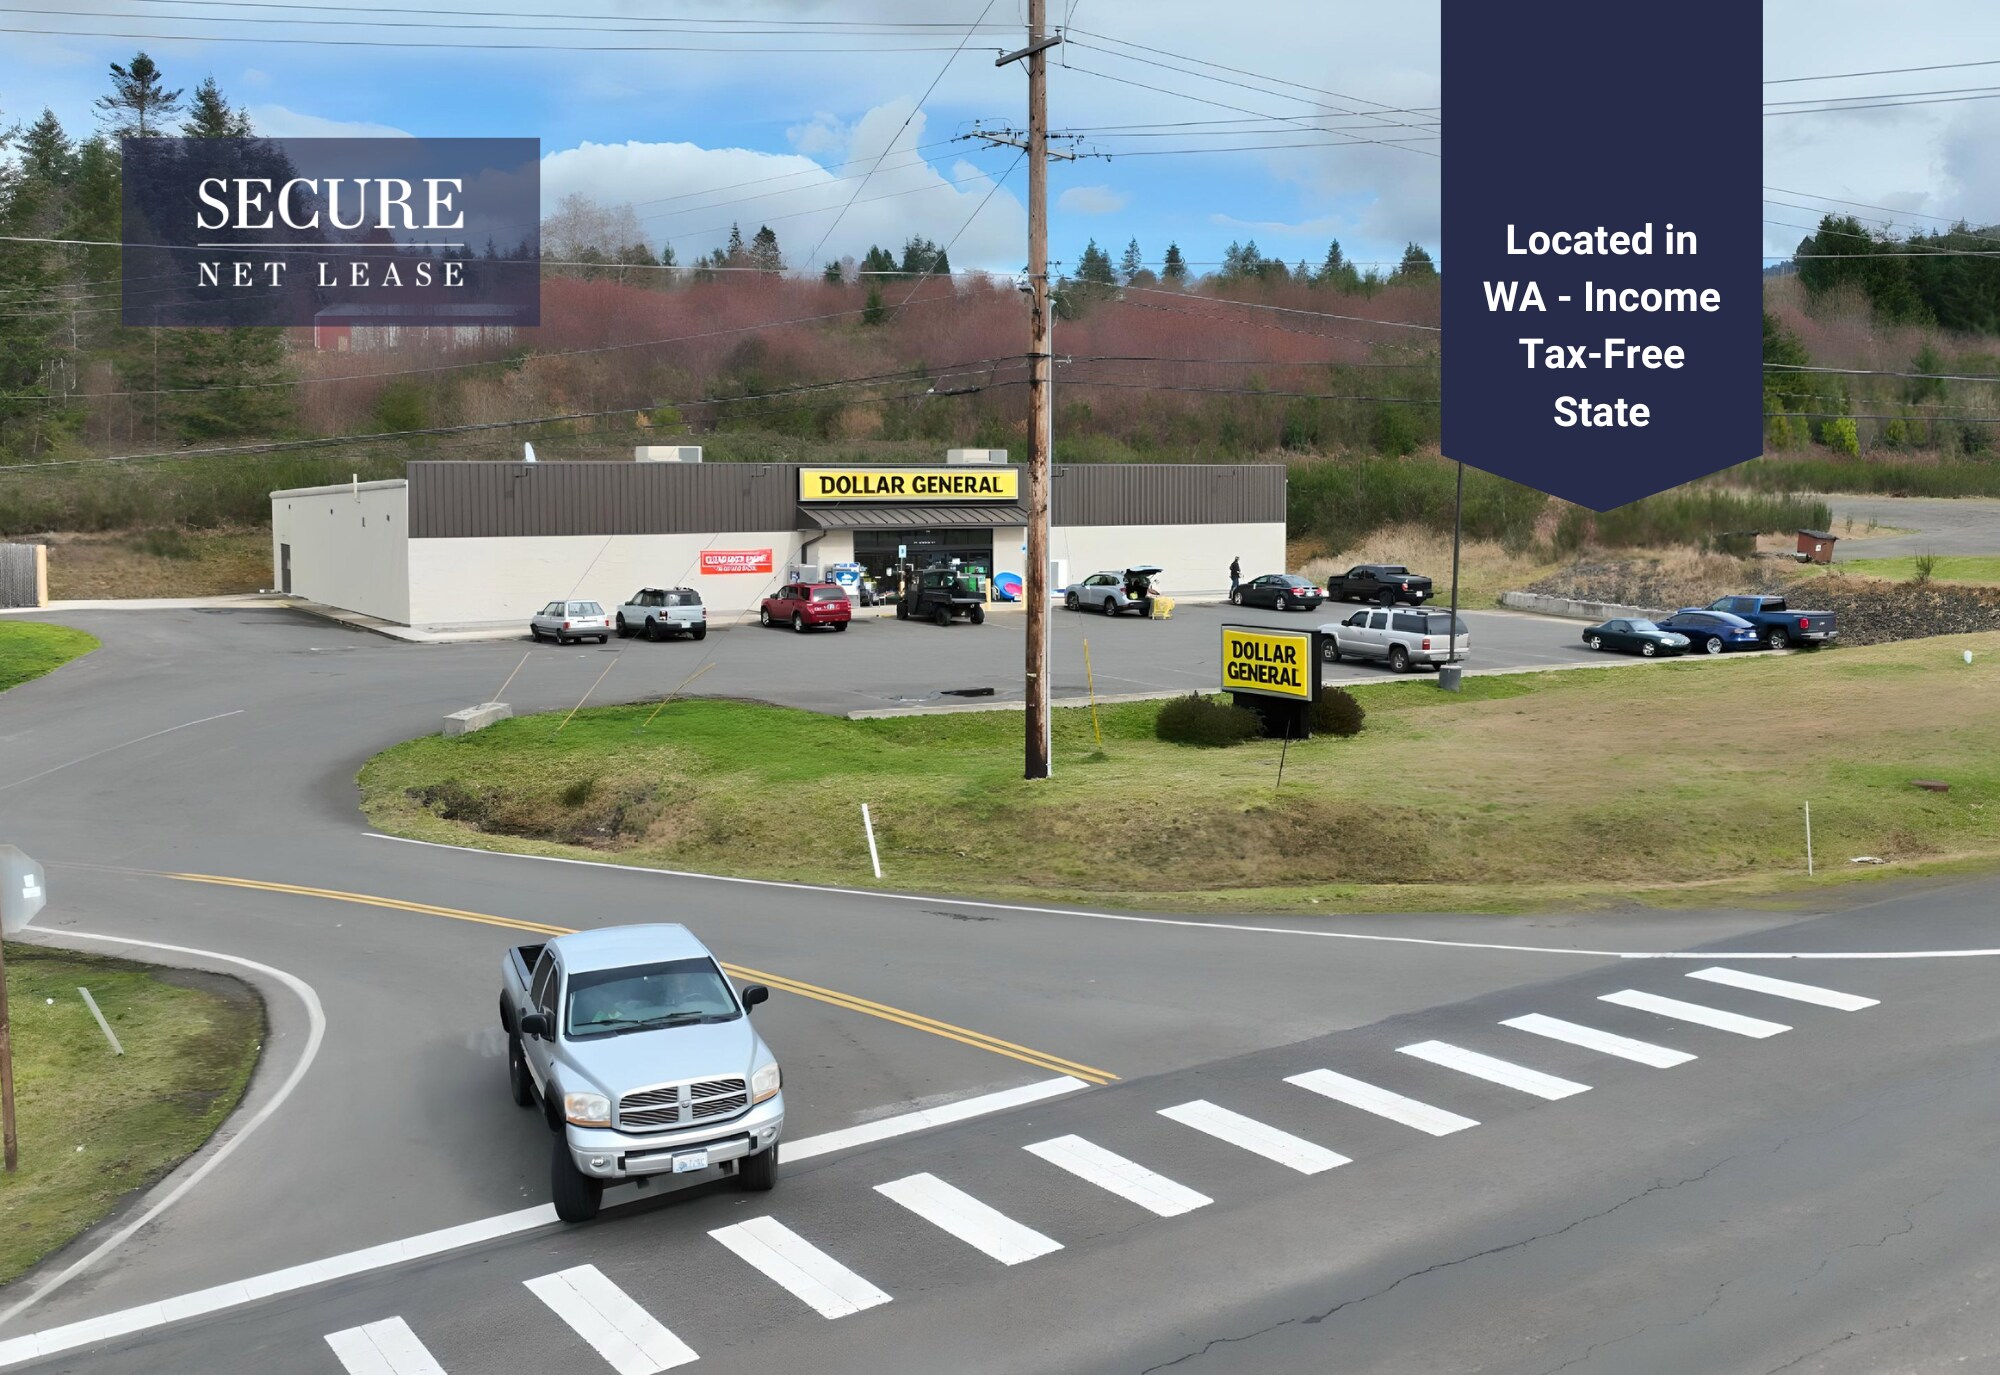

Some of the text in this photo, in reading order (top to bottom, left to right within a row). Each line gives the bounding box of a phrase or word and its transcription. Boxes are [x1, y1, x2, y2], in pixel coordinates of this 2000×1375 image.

[819, 475, 1004, 494] DOLLAR GENERAL
[1231, 640, 1297, 665] DOLLAR
[1227, 661, 1302, 687] GENERAL
